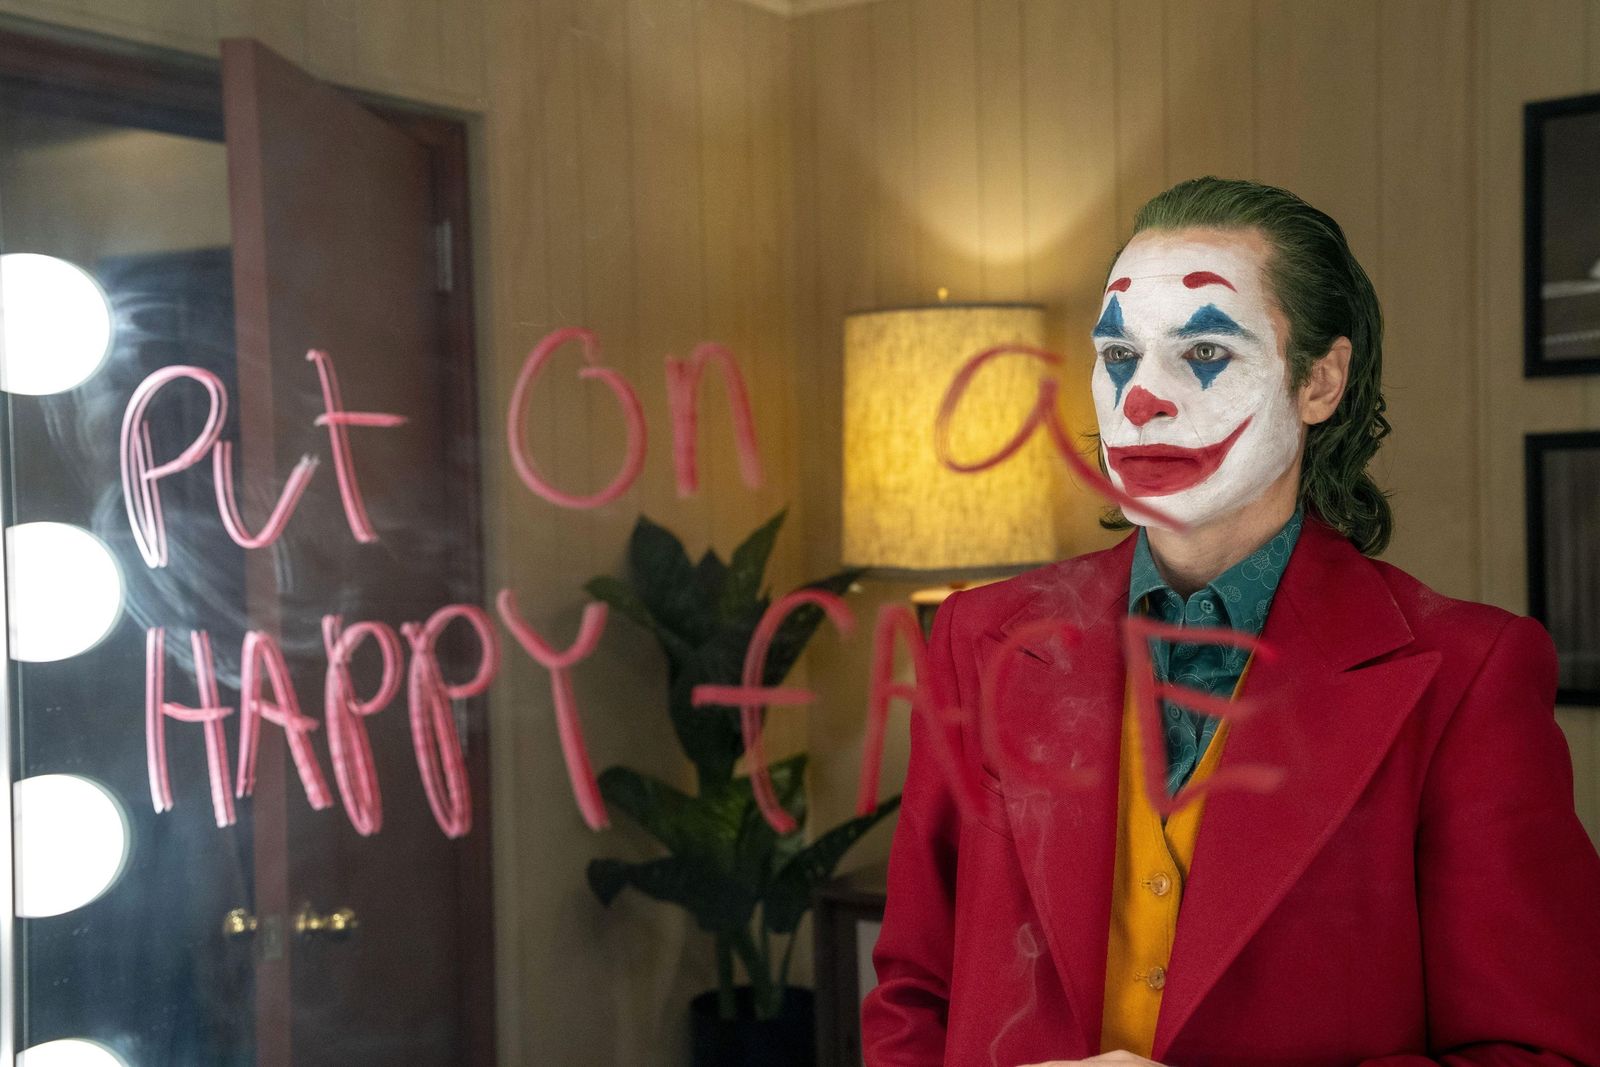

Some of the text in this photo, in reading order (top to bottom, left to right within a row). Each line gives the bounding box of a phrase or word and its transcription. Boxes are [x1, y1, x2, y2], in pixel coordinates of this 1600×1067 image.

[120, 349, 408, 569] Put
[934, 341, 1190, 534] a
[145, 588, 1290, 838] HAPPY FACE
